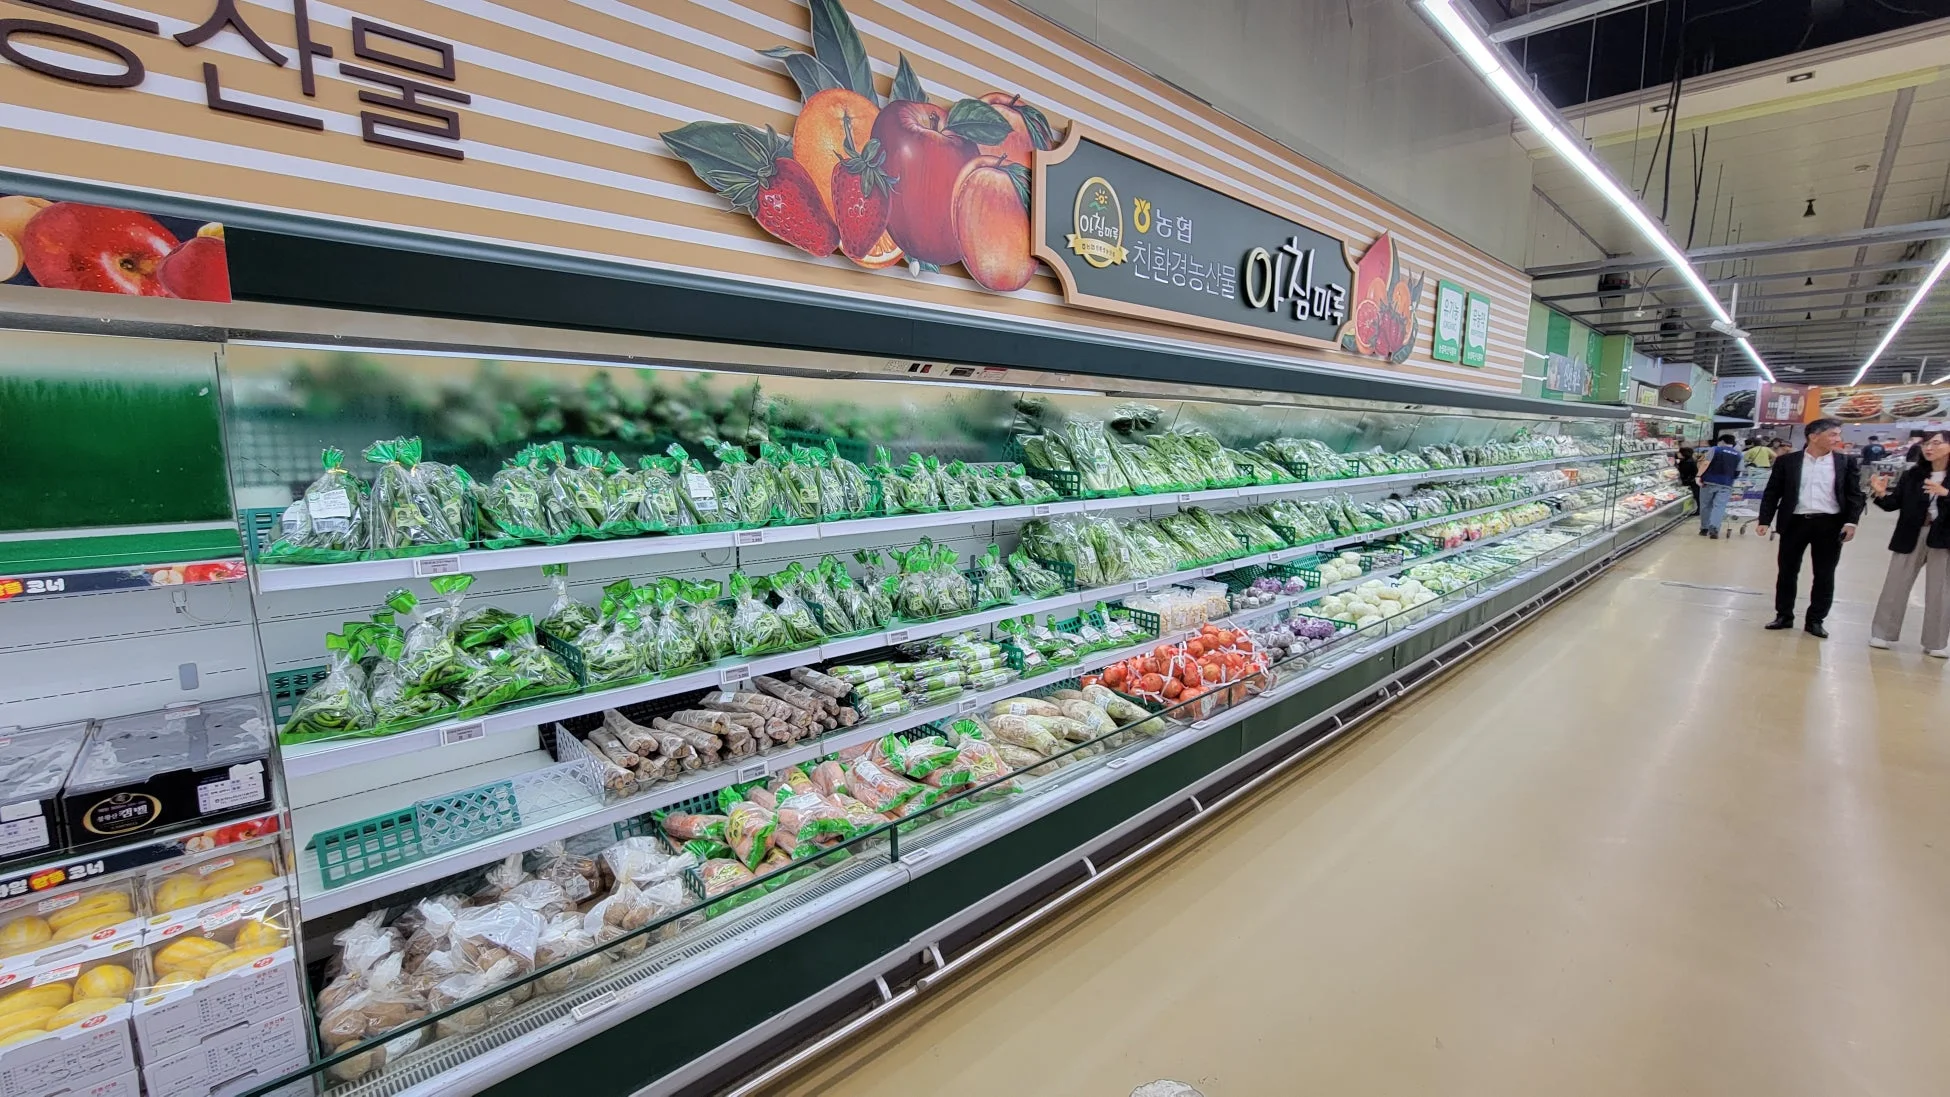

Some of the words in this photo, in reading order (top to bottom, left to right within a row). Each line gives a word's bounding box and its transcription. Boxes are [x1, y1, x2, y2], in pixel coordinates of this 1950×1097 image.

[1080, 212, 1119, 240] 아침마루
[1156, 209, 1193, 244] 농협
[1132, 241, 1237, 299] 친환경농산물
[1246, 236, 1346, 325] 아침마루
[1443, 299, 1459, 321] 유기농
[26, 578, 65, 594] 코너
[68, 860, 105, 880] 코너
